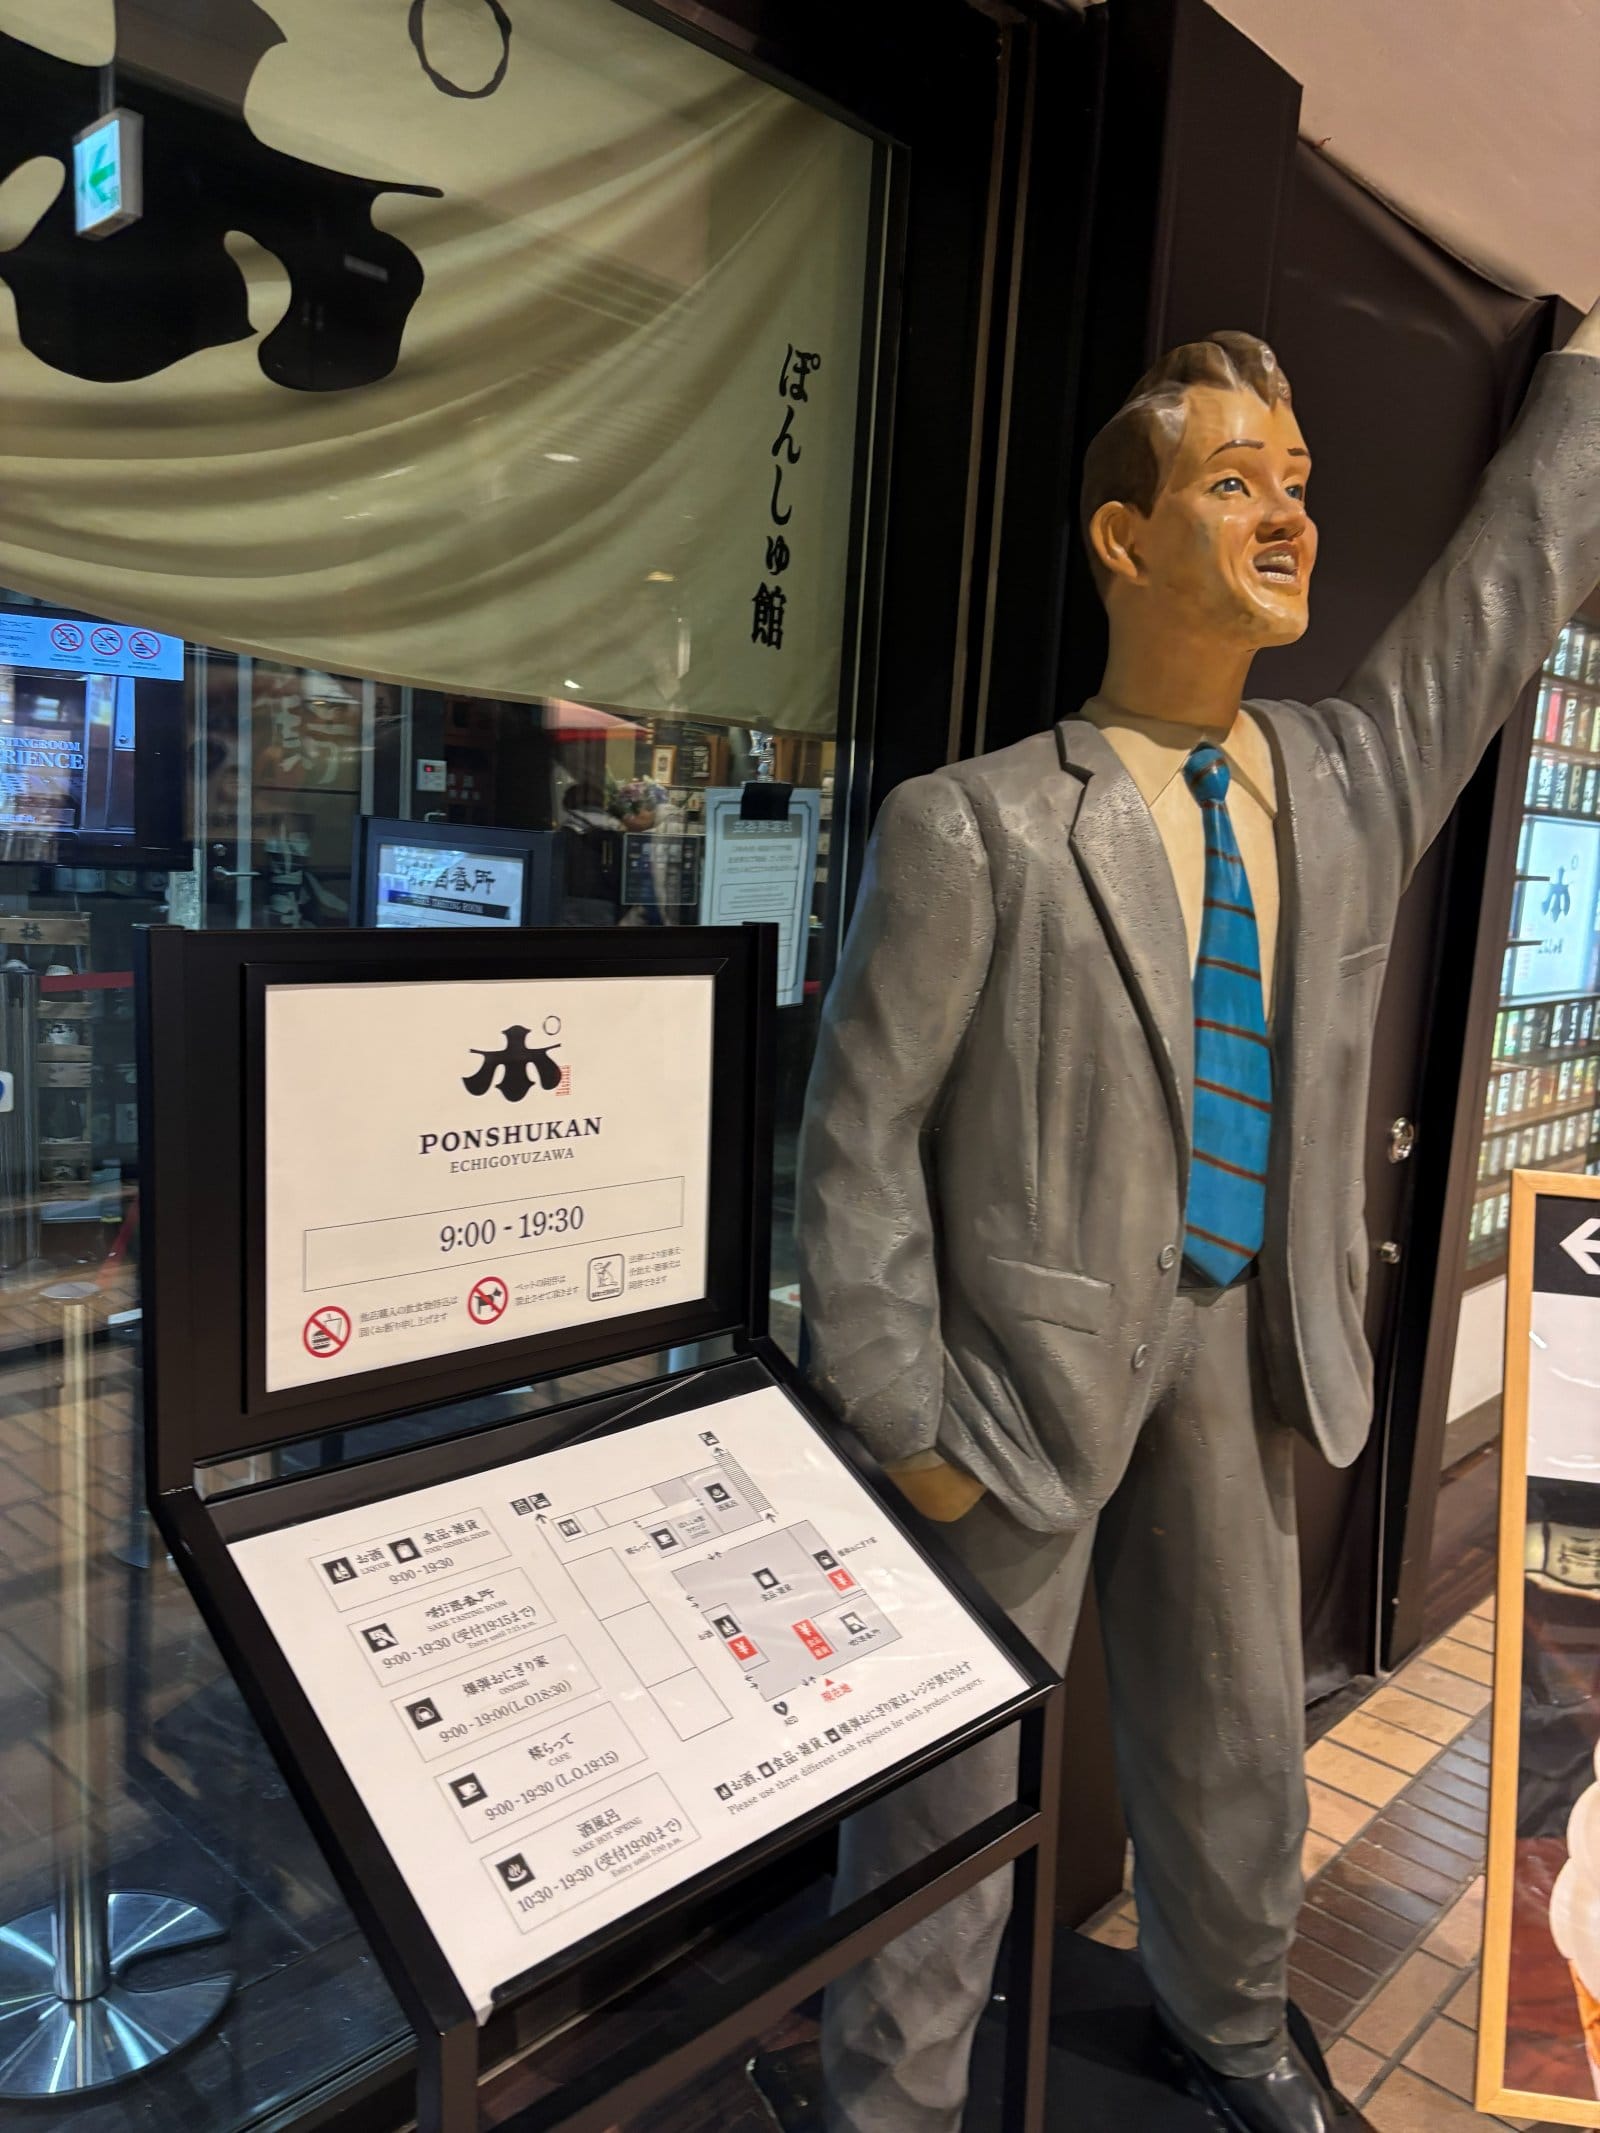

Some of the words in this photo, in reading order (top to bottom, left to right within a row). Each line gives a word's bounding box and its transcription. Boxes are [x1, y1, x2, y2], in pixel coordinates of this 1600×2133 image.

[751, 343, 822, 651] ぽんしゅ館
[419, 1117, 602, 1154] PONSHUKAN
[450, 1148, 574, 1173] ECHIGOYUZAWA
[440, 1219, 496, 1252] 9:00
[519, 1206, 583, 1238] 19:30
[356, 1548, 385, 1563] お酒
[389, 1570, 416, 1584] 9:00
[422, 1558, 454, 1574] 19:30
[382, 1652, 411, 1668] 9:00
[417, 1637, 451, 1656] 19:30
[462, 1655, 549, 1696] 爆弾おにぎり家
[821, 1684, 852, 1701] 現在地
[439, 1724, 468, 1742] 9:00
[485, 1800, 514, 1820] 9:00
[520, 1781, 554, 1804] 19:30
[576, 1809, 621, 1838] 酒風呂
[518, 1886, 553, 1912] 10:30
[559, 1865, 594, 1890] 19:30
